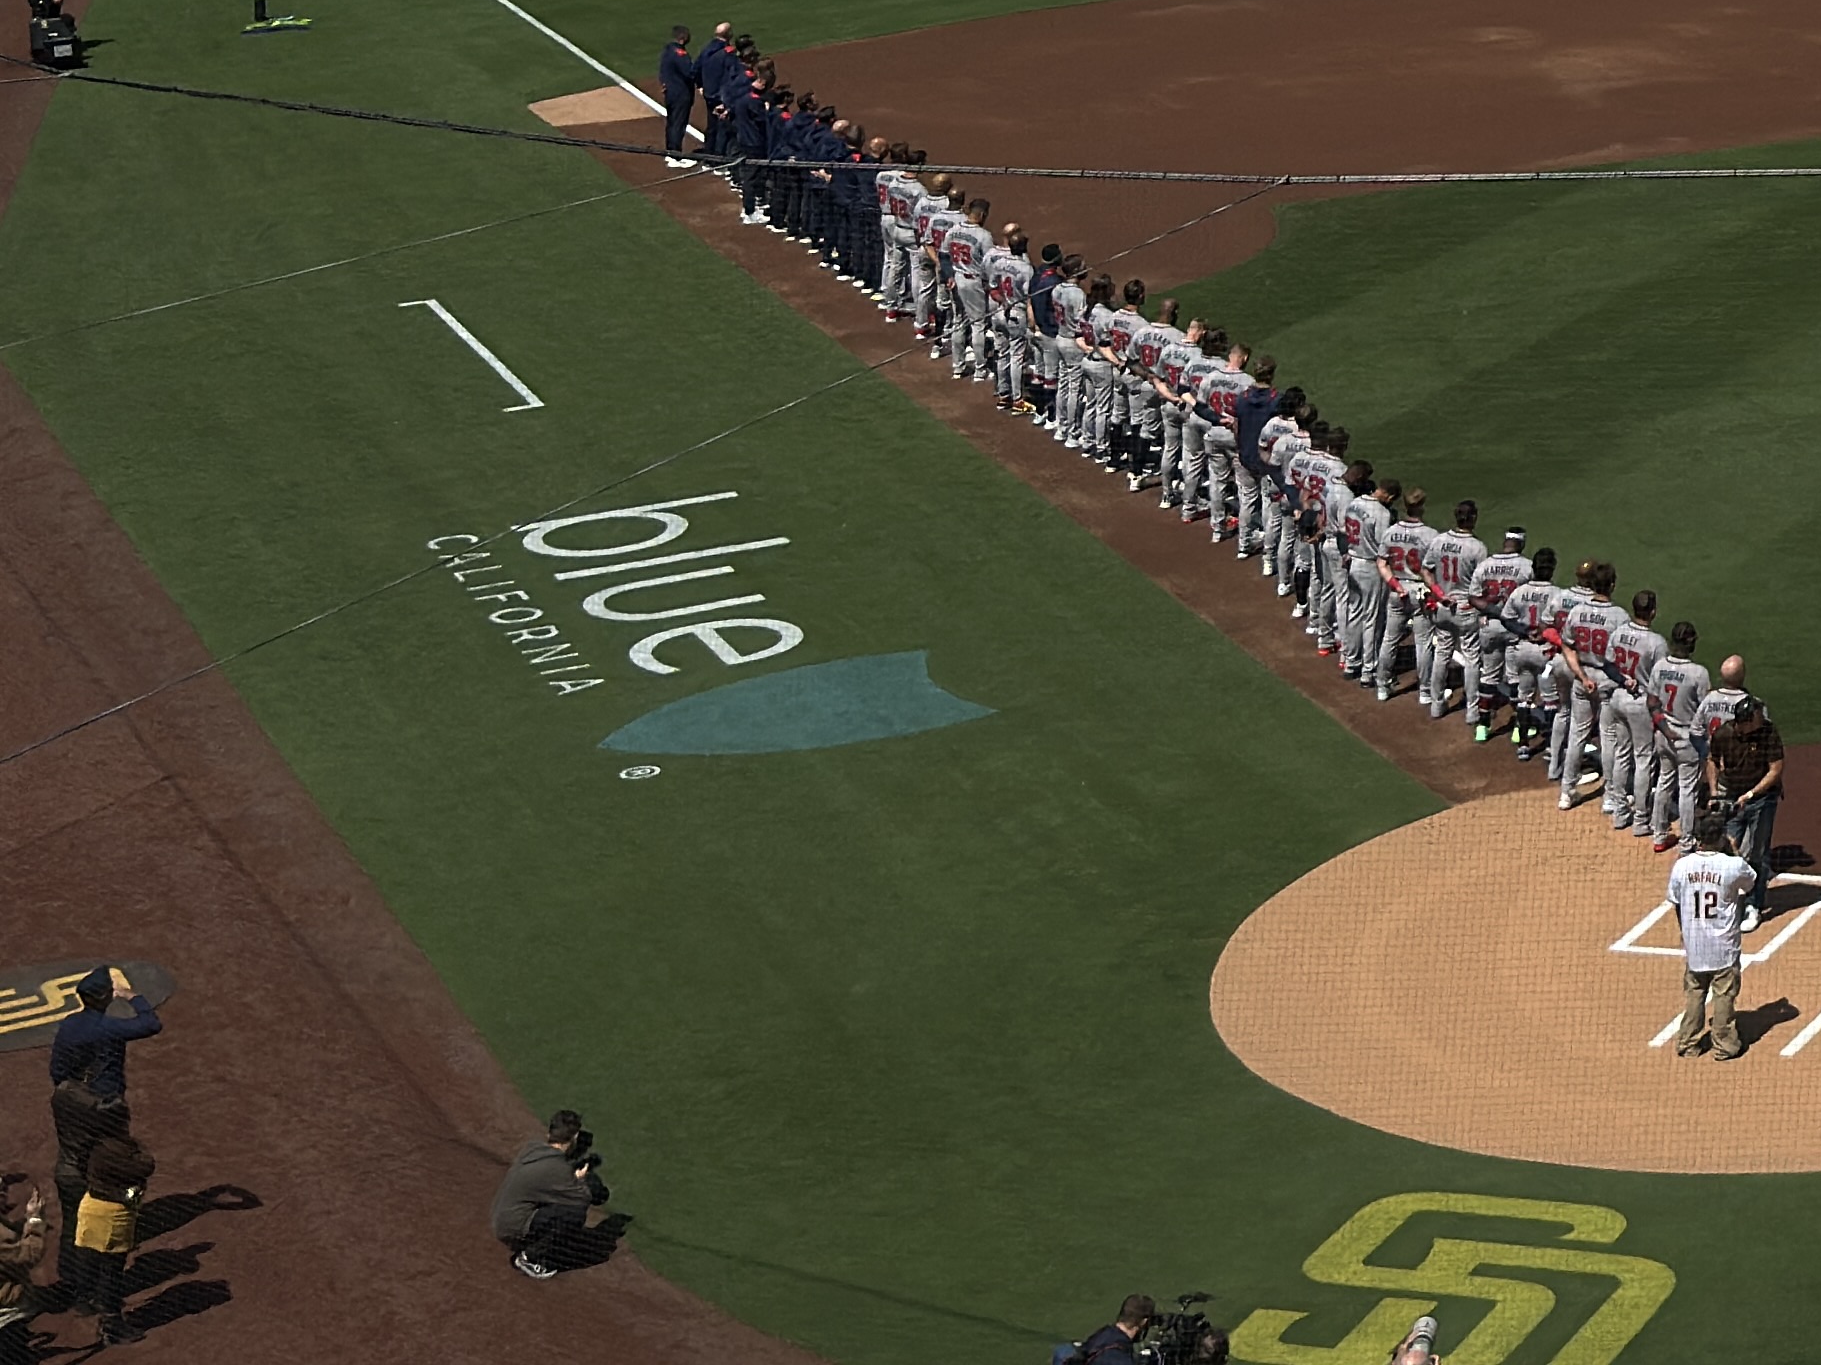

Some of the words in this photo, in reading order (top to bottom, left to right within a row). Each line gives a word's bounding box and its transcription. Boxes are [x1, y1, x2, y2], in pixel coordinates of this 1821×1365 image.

[1388, 546, 1422, 574] 24
[1440, 555, 1460, 583] 11
[511, 490, 805, 676] blue
[427, 533, 605, 697] CALIFORNIA
[1528, 604, 1538, 631] 1
[1579, 612, 1607, 626] OLSON
[1574, 626, 1609, 656] 28
[1613, 646, 1641, 679] 27
[1664, 683, 1678, 713] 7
[1688, 871, 1722, 886] RAFAEL
[1693, 889, 1718, 919] 12
